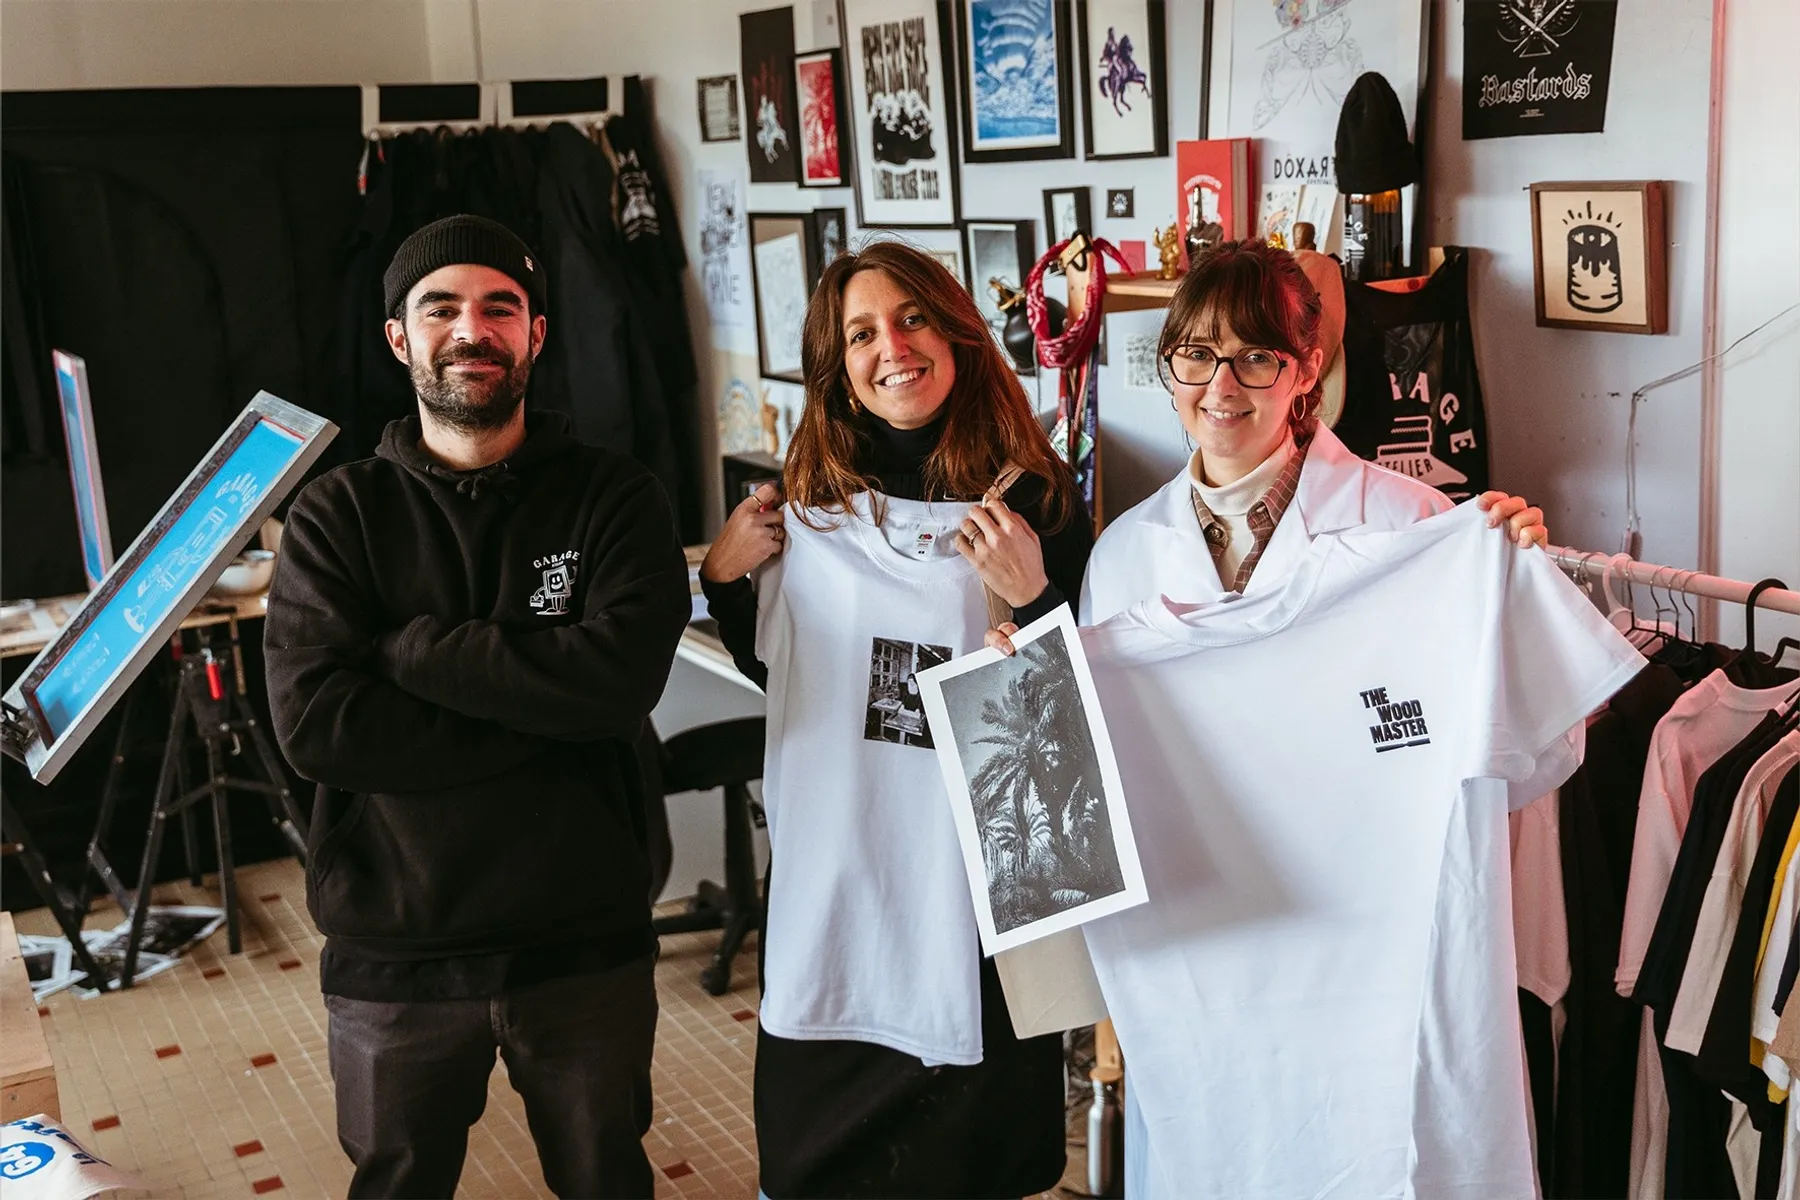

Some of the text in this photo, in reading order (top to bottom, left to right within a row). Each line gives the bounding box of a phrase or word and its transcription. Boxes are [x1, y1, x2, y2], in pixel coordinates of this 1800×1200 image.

[1479, 61, 1592, 107] Bastards
[1379, 458, 1434, 477] TELIER
[533, 550, 581, 569] GARAGE
[1359, 686, 1390, 709] THE
[1376, 699, 1423, 723] WOOD
[1369, 717, 1428, 743] MASTER
